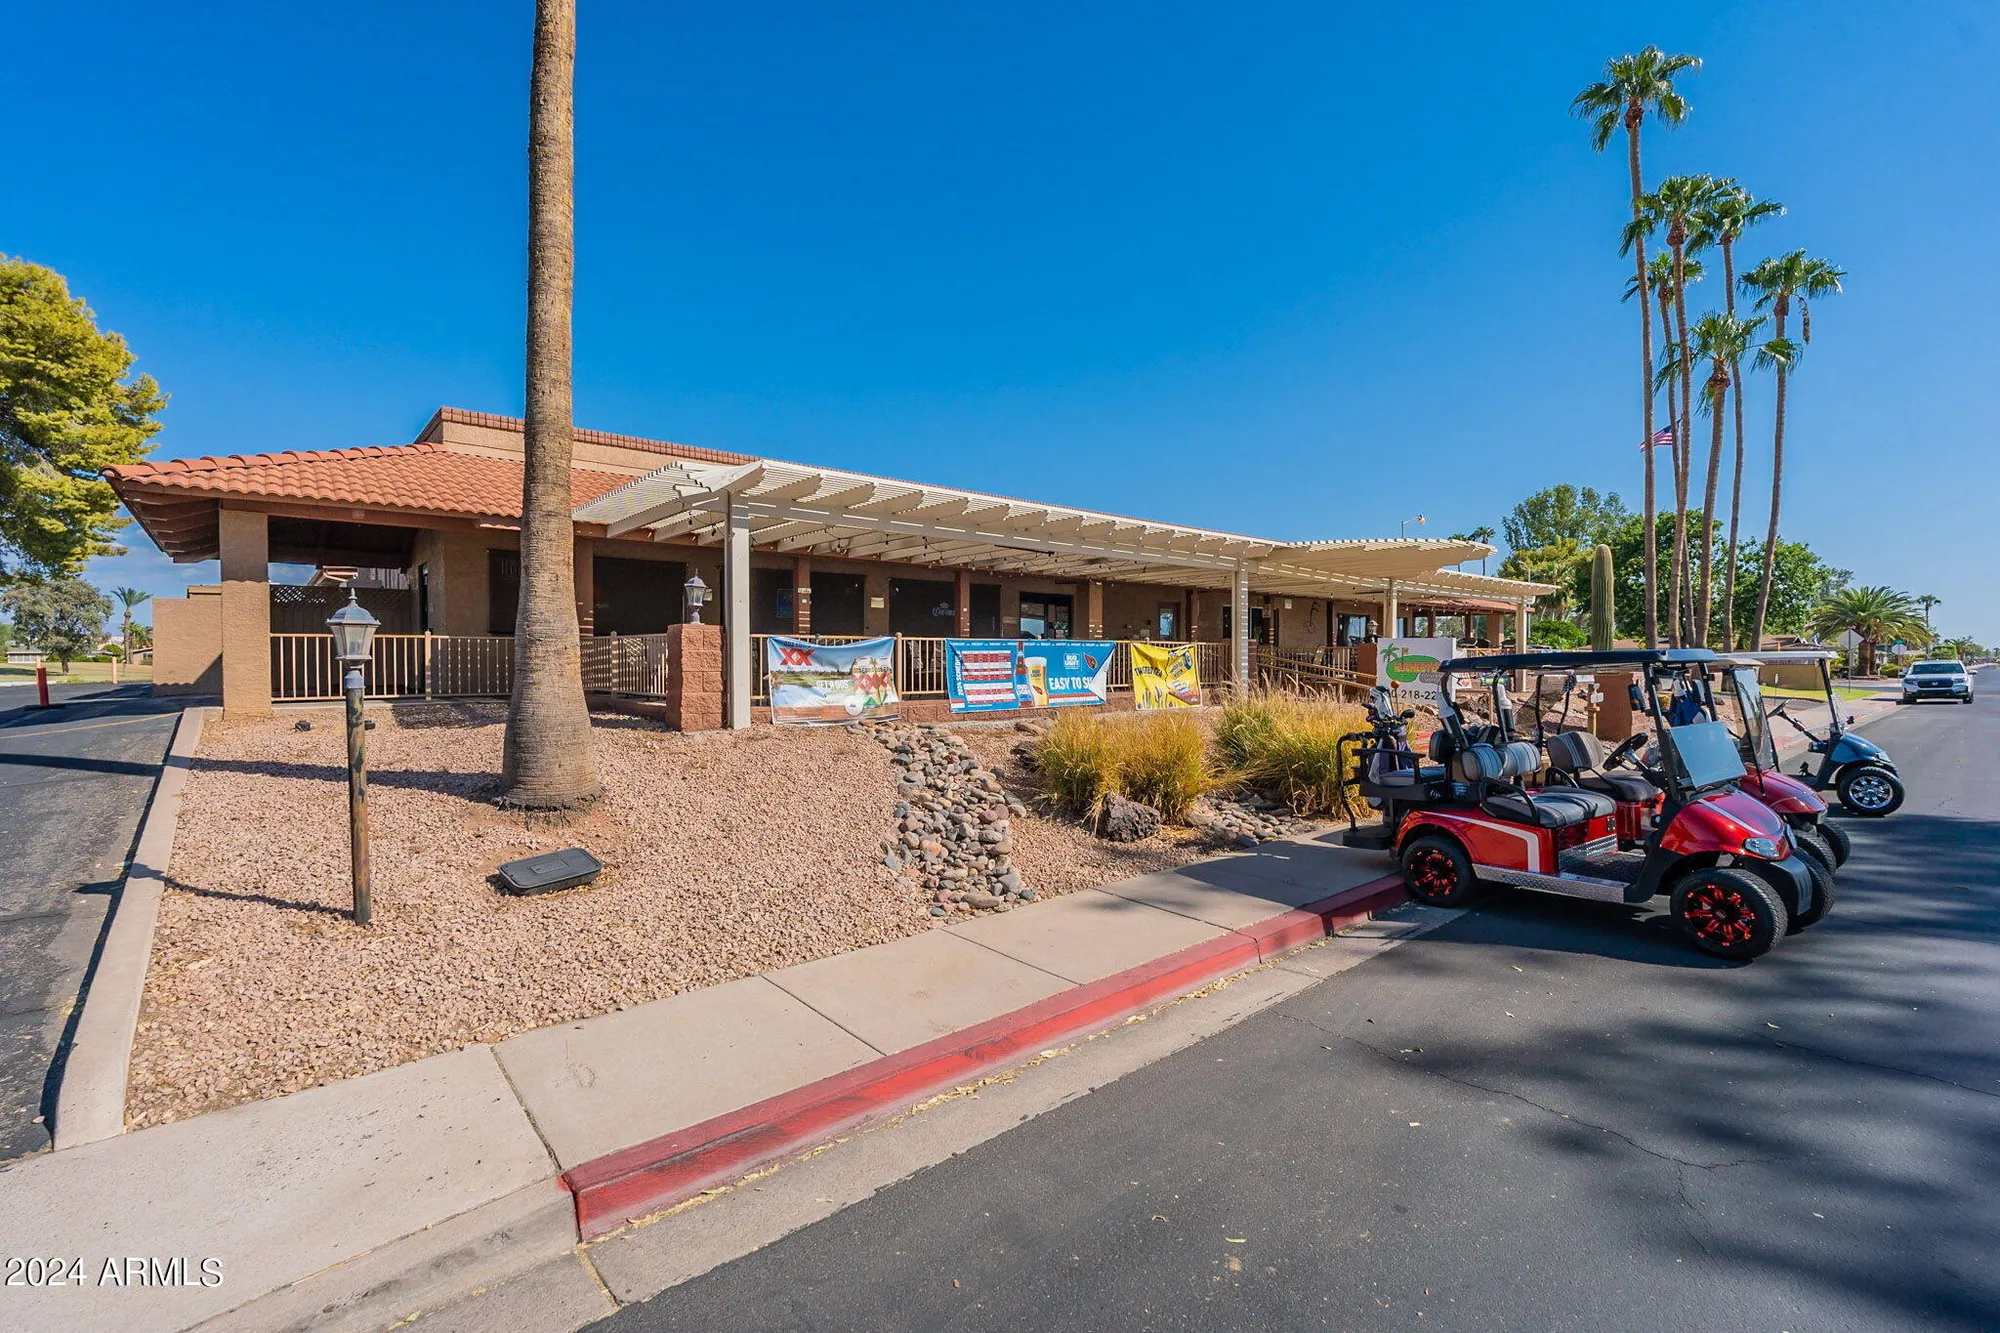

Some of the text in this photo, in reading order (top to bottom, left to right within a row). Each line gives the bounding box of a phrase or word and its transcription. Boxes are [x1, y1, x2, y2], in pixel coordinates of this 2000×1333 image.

[779, 648, 815, 666] XX
[1049, 677, 1069, 690] EASY
[1071, 677, 1082, 689] TO
